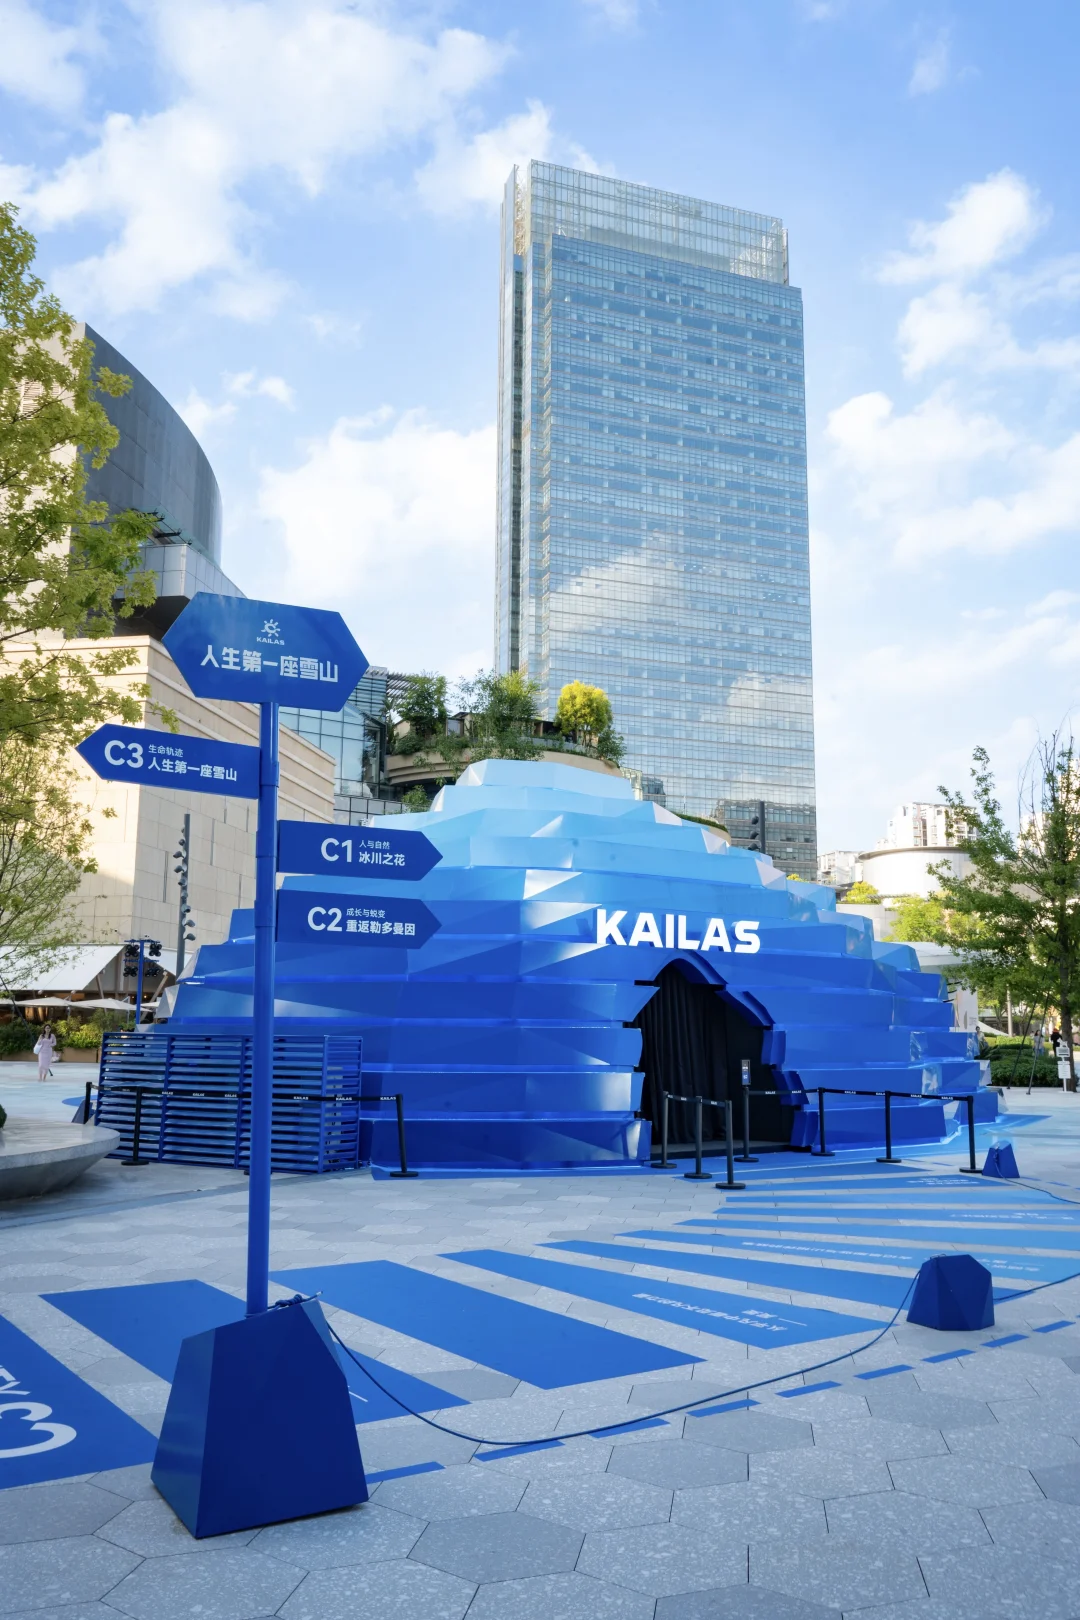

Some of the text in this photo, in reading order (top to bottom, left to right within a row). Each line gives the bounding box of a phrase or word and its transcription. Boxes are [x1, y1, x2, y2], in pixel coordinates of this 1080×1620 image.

[256, 636, 285, 645] KAILAS
[200, 645, 339, 683] 人生第一座雪山
[104, 740, 144, 768] C3
[148, 744, 184, 757] 生命轨迹
[148, 757, 237, 781] 人生第一座雪山
[320, 838, 353, 862] C1
[359, 840, 390, 849] 人与自然
[358, 851, 406, 866] 冰川之花
[307, 906, 343, 932] C2
[346, 908, 386, 919] 成长与蜕变
[346, 919, 416, 936] 重返勒多曼因
[596, 909, 761, 954] KAILAS
